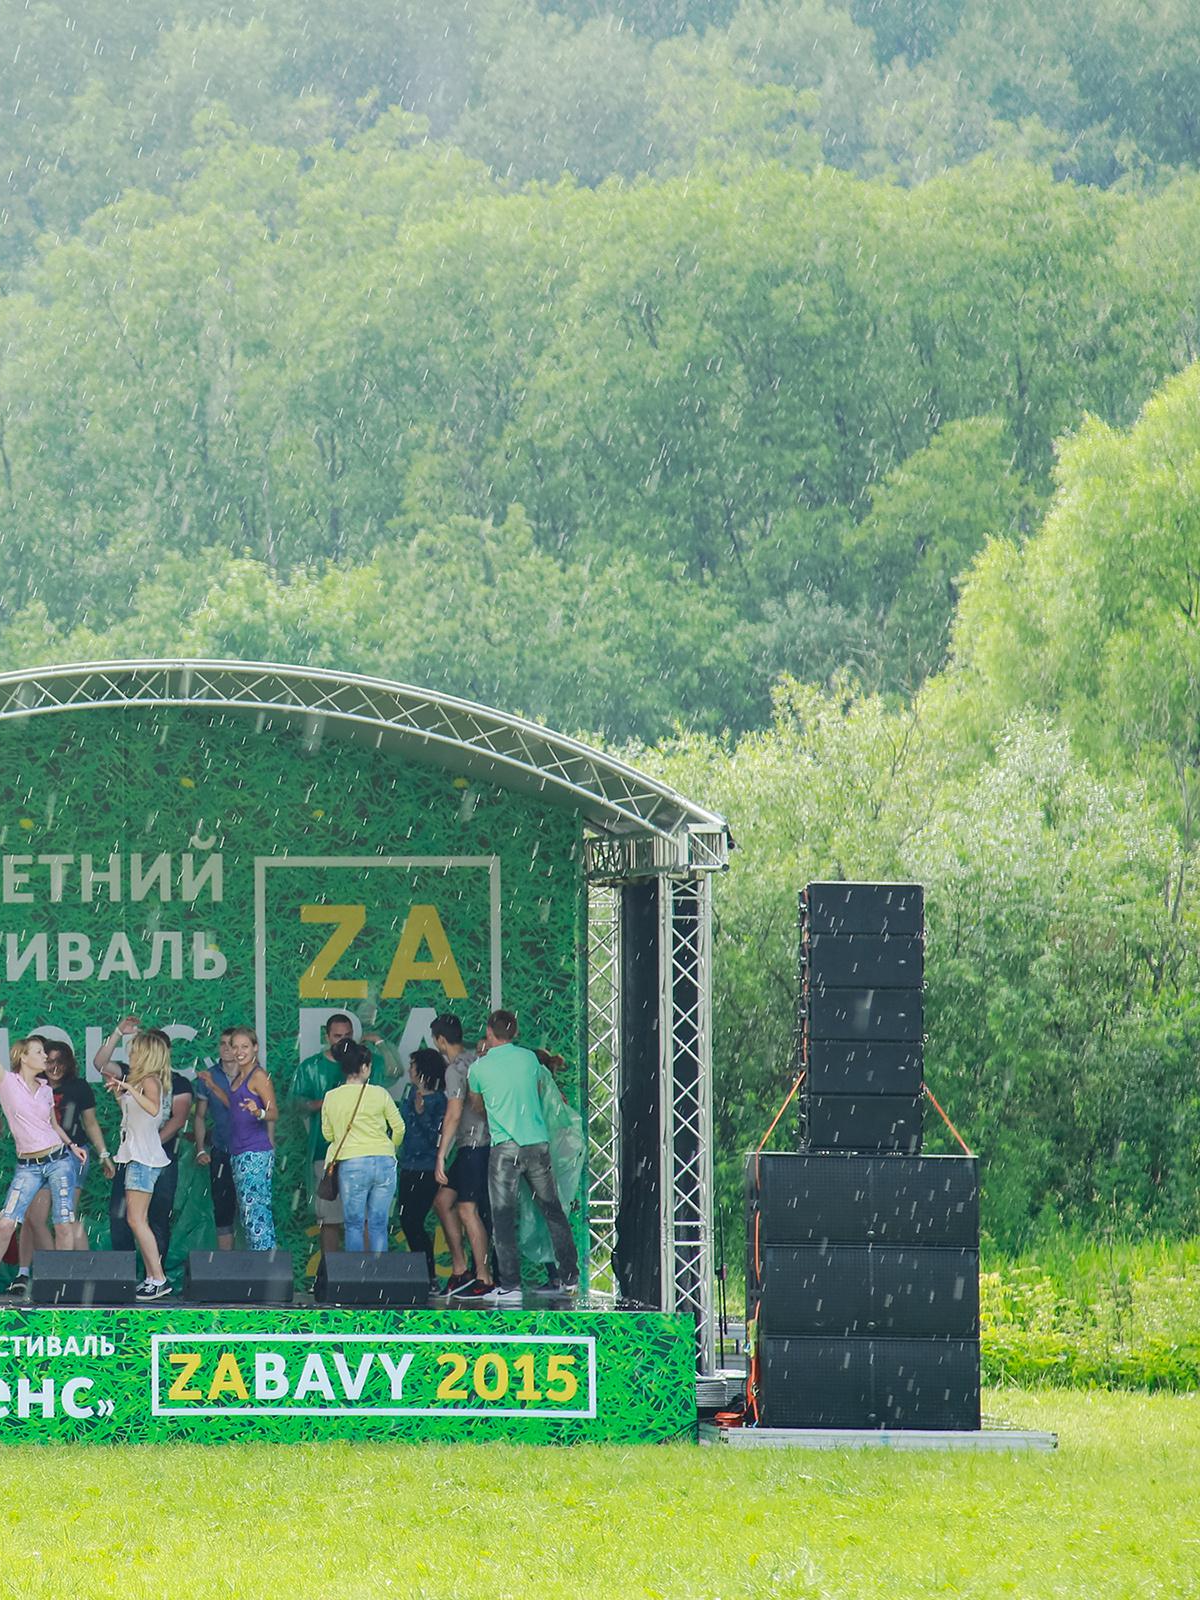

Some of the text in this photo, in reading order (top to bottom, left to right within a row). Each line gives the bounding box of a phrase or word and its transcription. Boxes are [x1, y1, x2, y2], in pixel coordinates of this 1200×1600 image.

[299, 904, 469, 999] ZA
[168, 1352, 578, 1402] ZABAVY 2015
